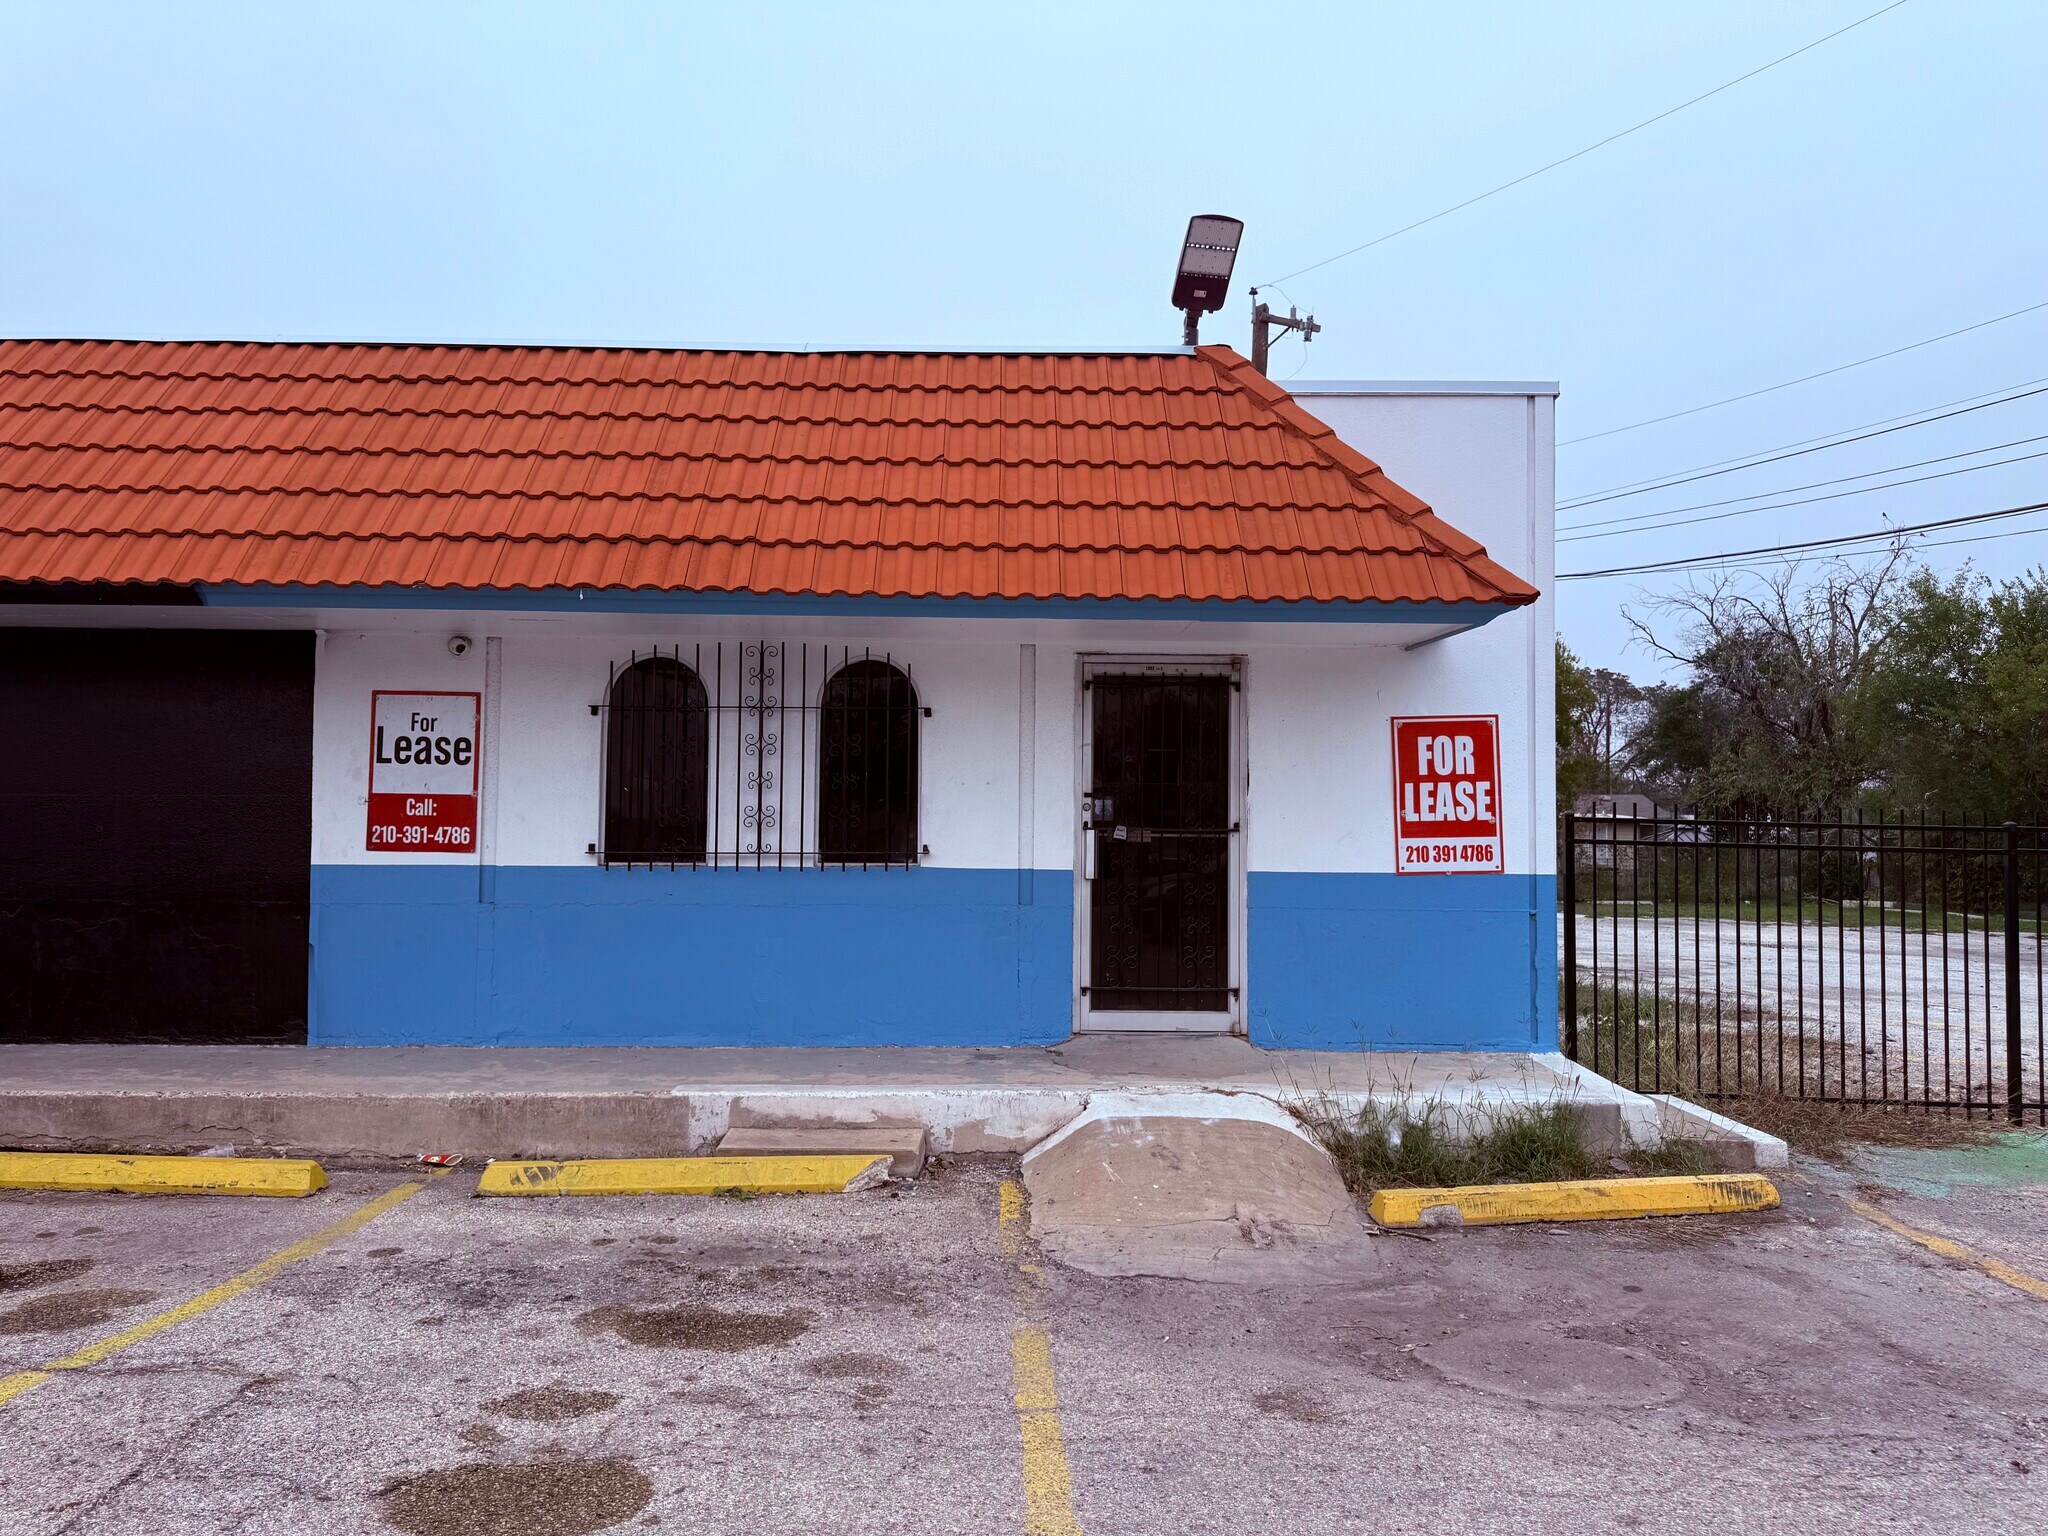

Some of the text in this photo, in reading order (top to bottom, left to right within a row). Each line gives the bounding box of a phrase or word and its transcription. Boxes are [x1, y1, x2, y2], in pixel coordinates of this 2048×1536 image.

[410, 712, 437, 732] For
[376, 726, 471, 765] Lease
[1417, 735, 1475, 776] FOR
[406, 798, 437, 816] Call:
[1404, 781, 1493, 822] LEASE
[371, 825, 470, 844] 210-391-4786
[1405, 844, 1494, 863] 210 391 4786
